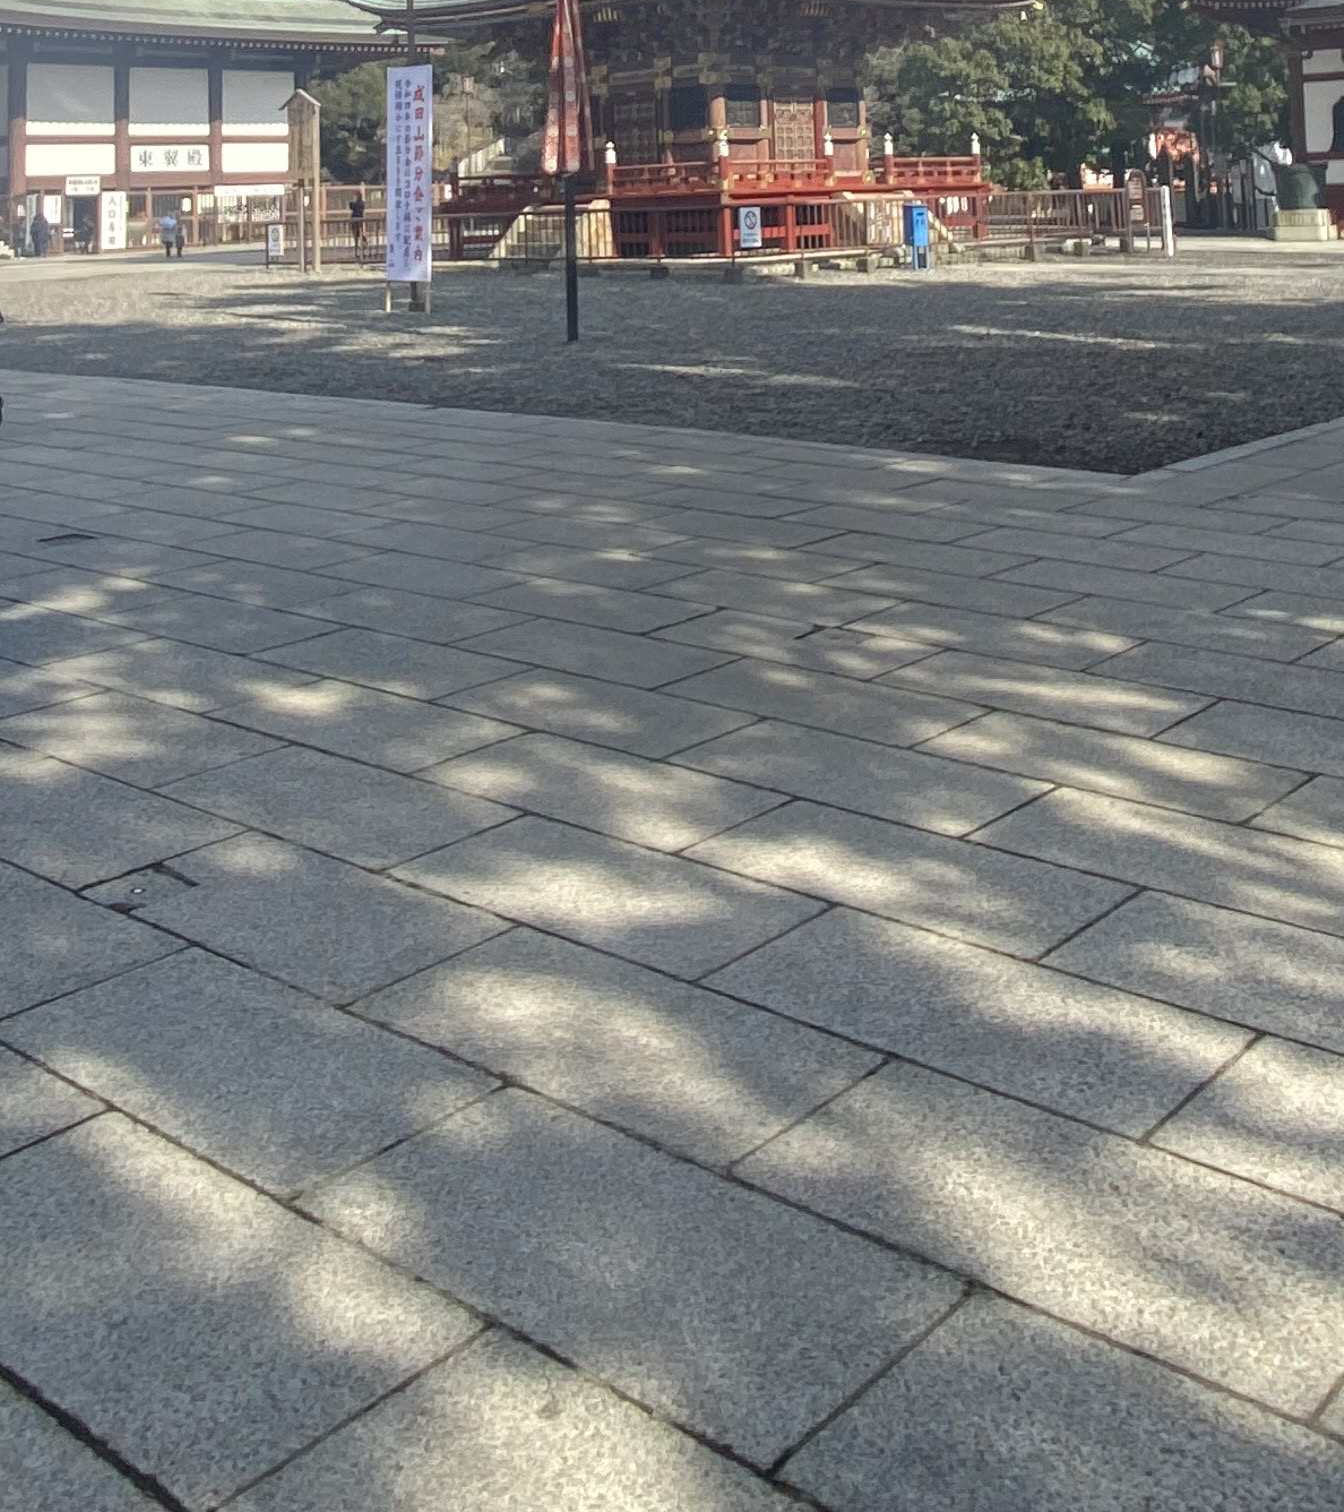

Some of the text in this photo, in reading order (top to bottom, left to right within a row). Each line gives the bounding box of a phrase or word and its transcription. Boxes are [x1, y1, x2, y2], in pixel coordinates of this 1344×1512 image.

[138, 148, 203, 168] 東翼殿
[107, 195, 118, 245] 入口専用
